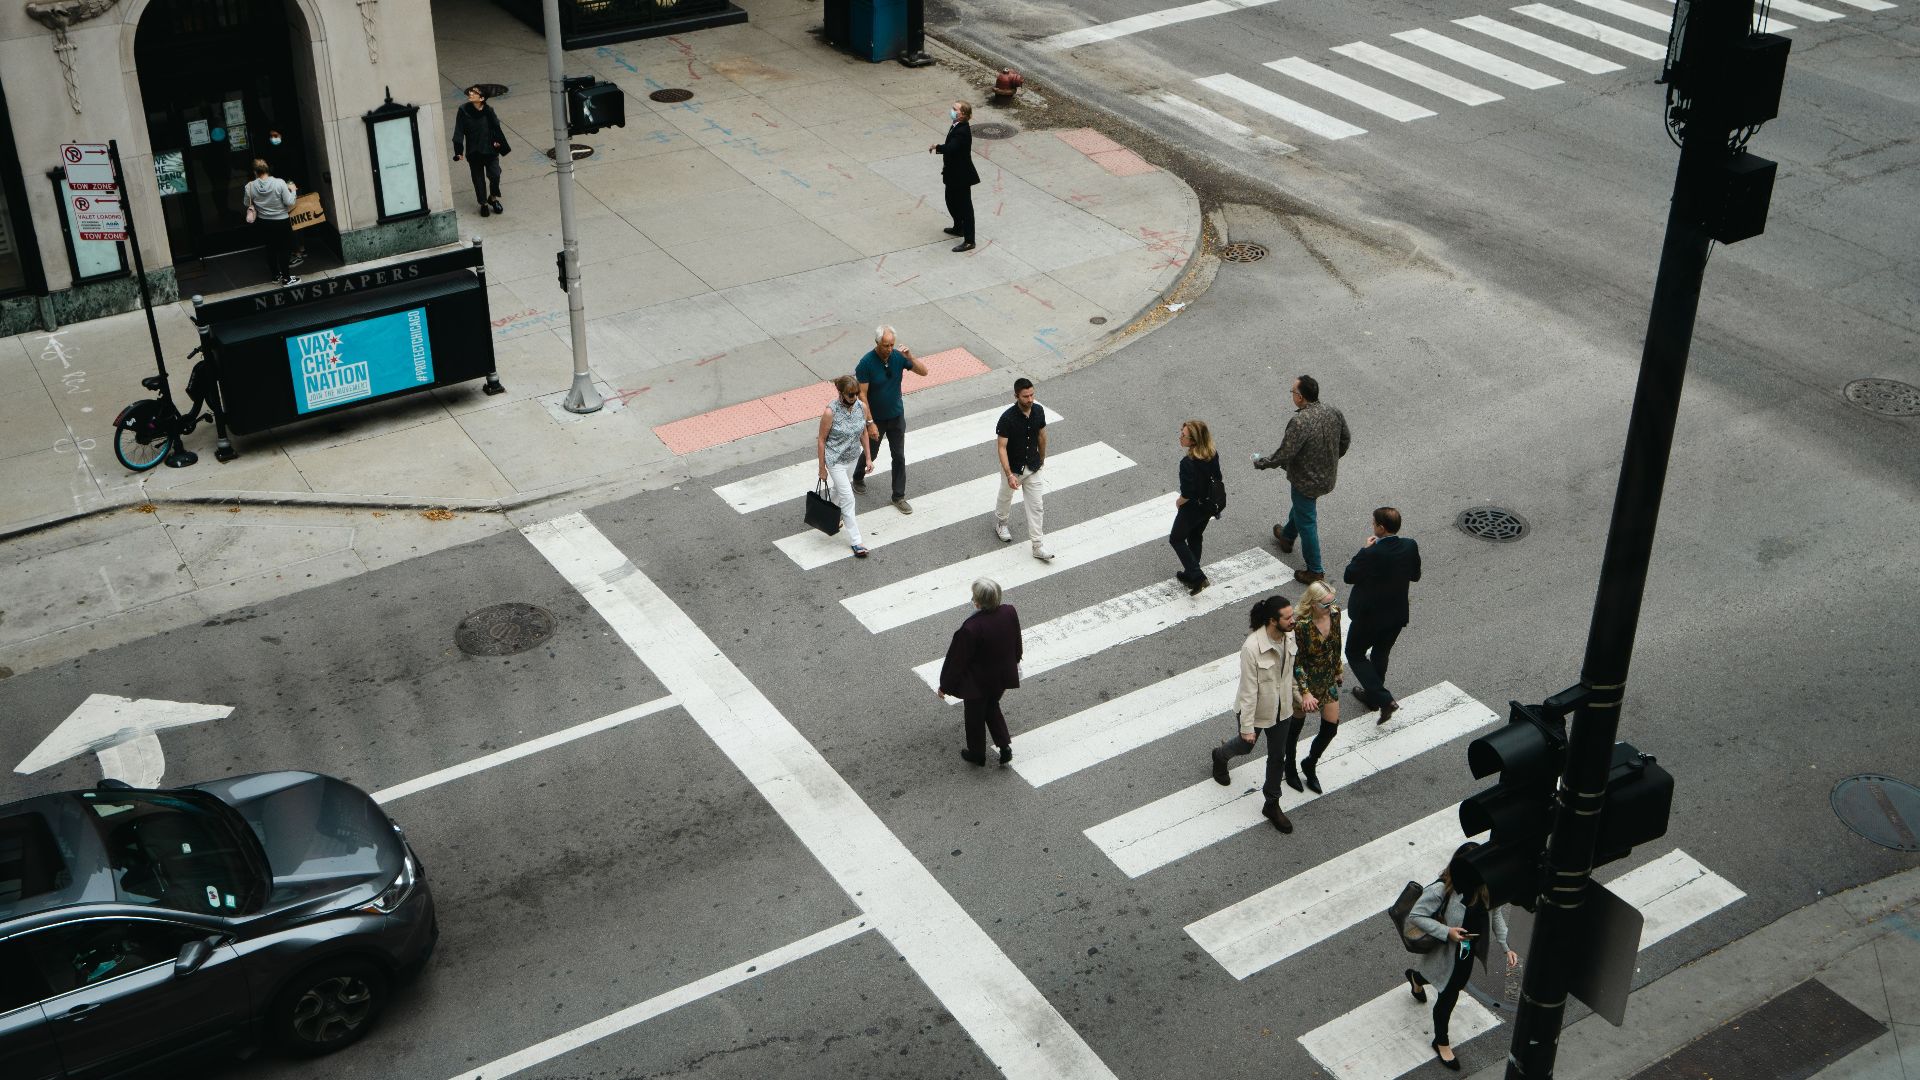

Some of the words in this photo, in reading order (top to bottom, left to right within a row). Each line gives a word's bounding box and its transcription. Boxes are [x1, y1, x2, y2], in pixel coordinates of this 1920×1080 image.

[290, 210, 312, 226] NIKE
[254, 264, 420, 311] NEWSPAPERS
[299, 332, 334, 356] VAX
[408, 310, 428, 382] #PROTECTCHICAGO
[306, 364, 367, 394] NATION
[308, 391, 323, 402] JOIN
[324, 388, 335, 398] THE
[336, 381, 369, 395] MOVEMENT
